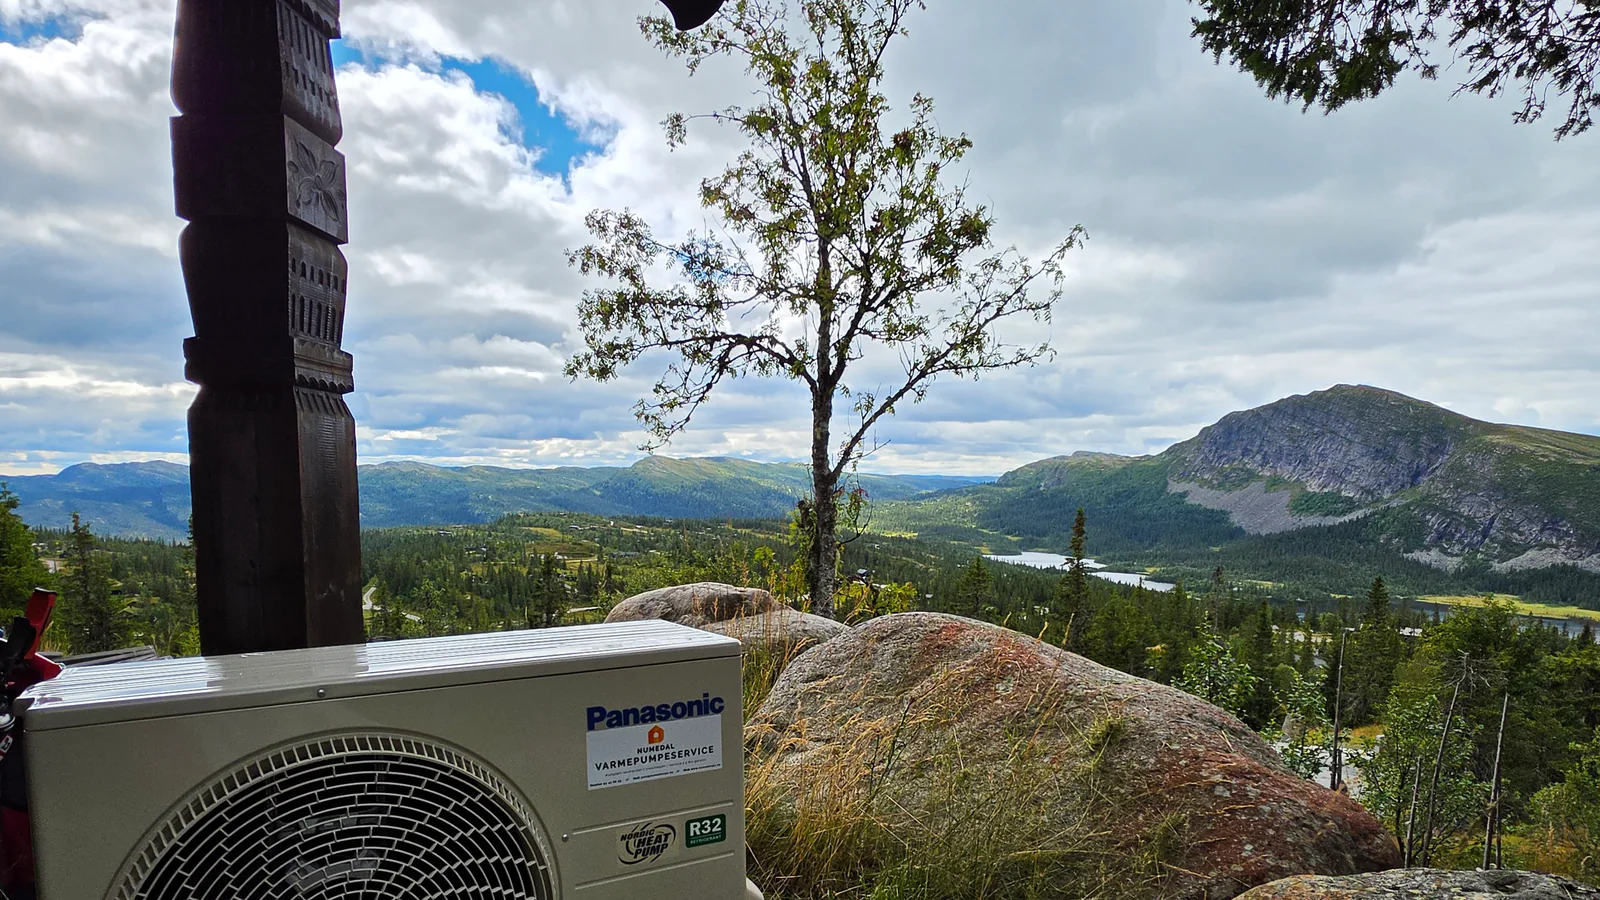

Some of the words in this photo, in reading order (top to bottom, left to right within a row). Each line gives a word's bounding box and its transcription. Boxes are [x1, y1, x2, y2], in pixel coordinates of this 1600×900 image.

[586, 692, 725, 731] Panasonic
[636, 743, 675, 755] NUMEDAL
[595, 745, 715, 771] VARMEPUMPESERVICE
[620, 828, 656, 842] NORDIC
[689, 818, 722, 837] R32
[636, 832, 672, 849] HEAT
[689, 834, 722, 845] REFRIGERANT
[633, 842, 669, 859] PUMP
